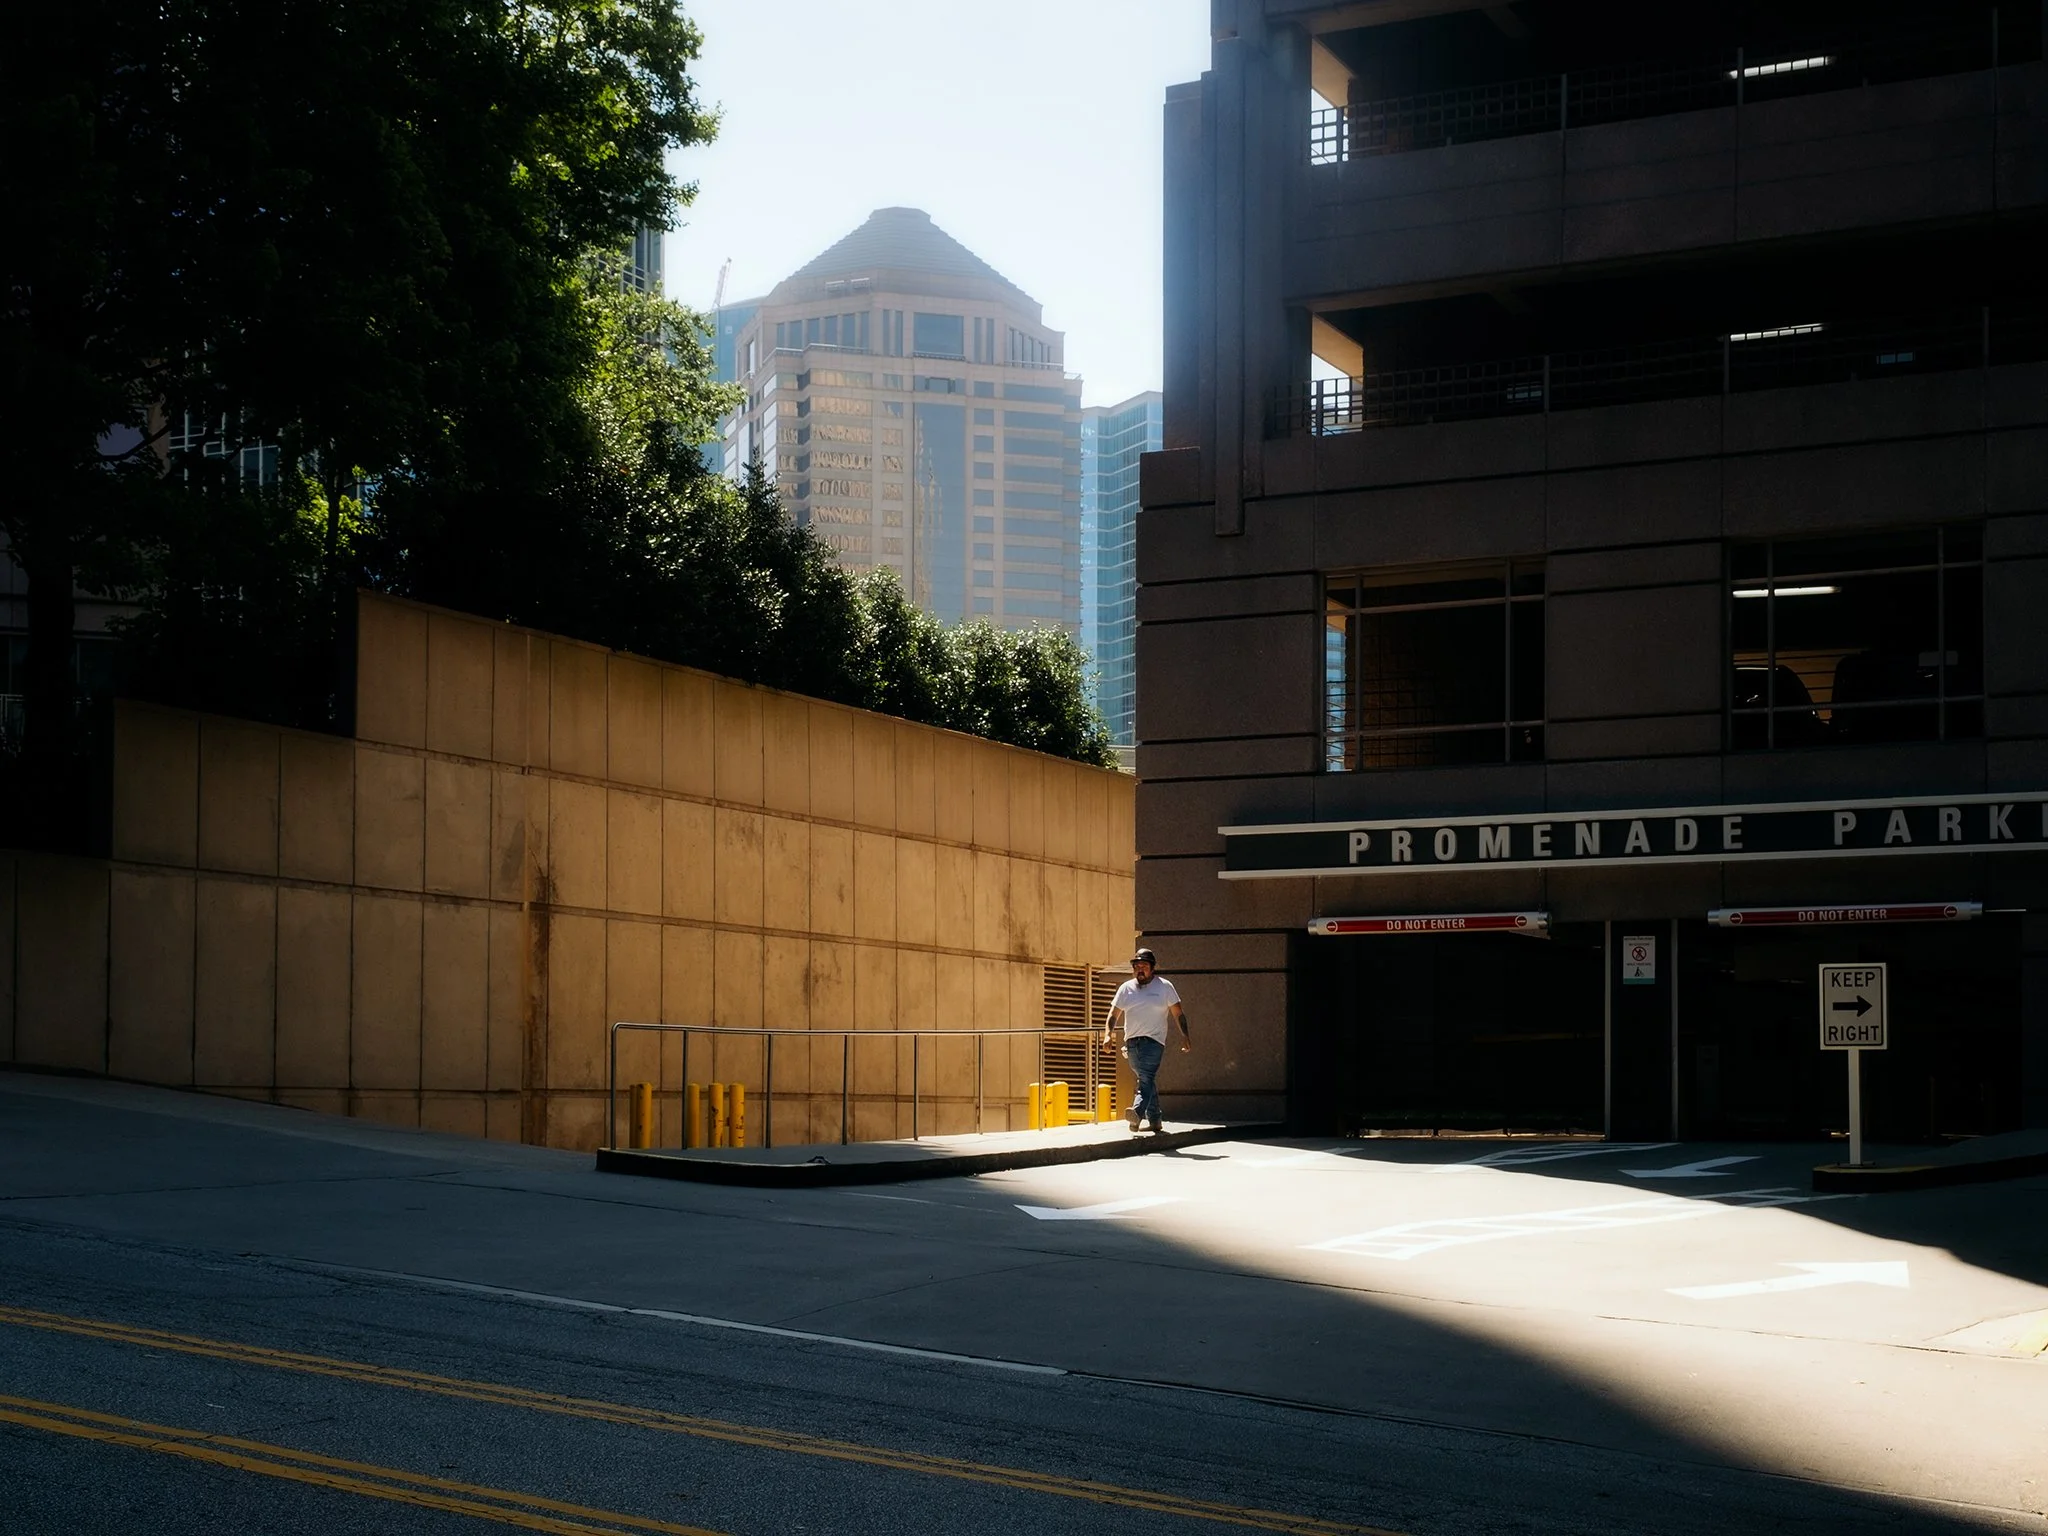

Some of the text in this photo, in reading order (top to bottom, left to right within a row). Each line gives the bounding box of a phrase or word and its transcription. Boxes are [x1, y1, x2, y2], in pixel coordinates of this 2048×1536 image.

[1348, 815, 1744, 865] PROMENADE
[1798, 909, 1887, 921] DO NOT ENTER
[1387, 918, 1466, 930] DO NOT ENTER
[1831, 971, 1876, 987] KEEP
[1828, 1025, 1879, 1041] RIGHT
